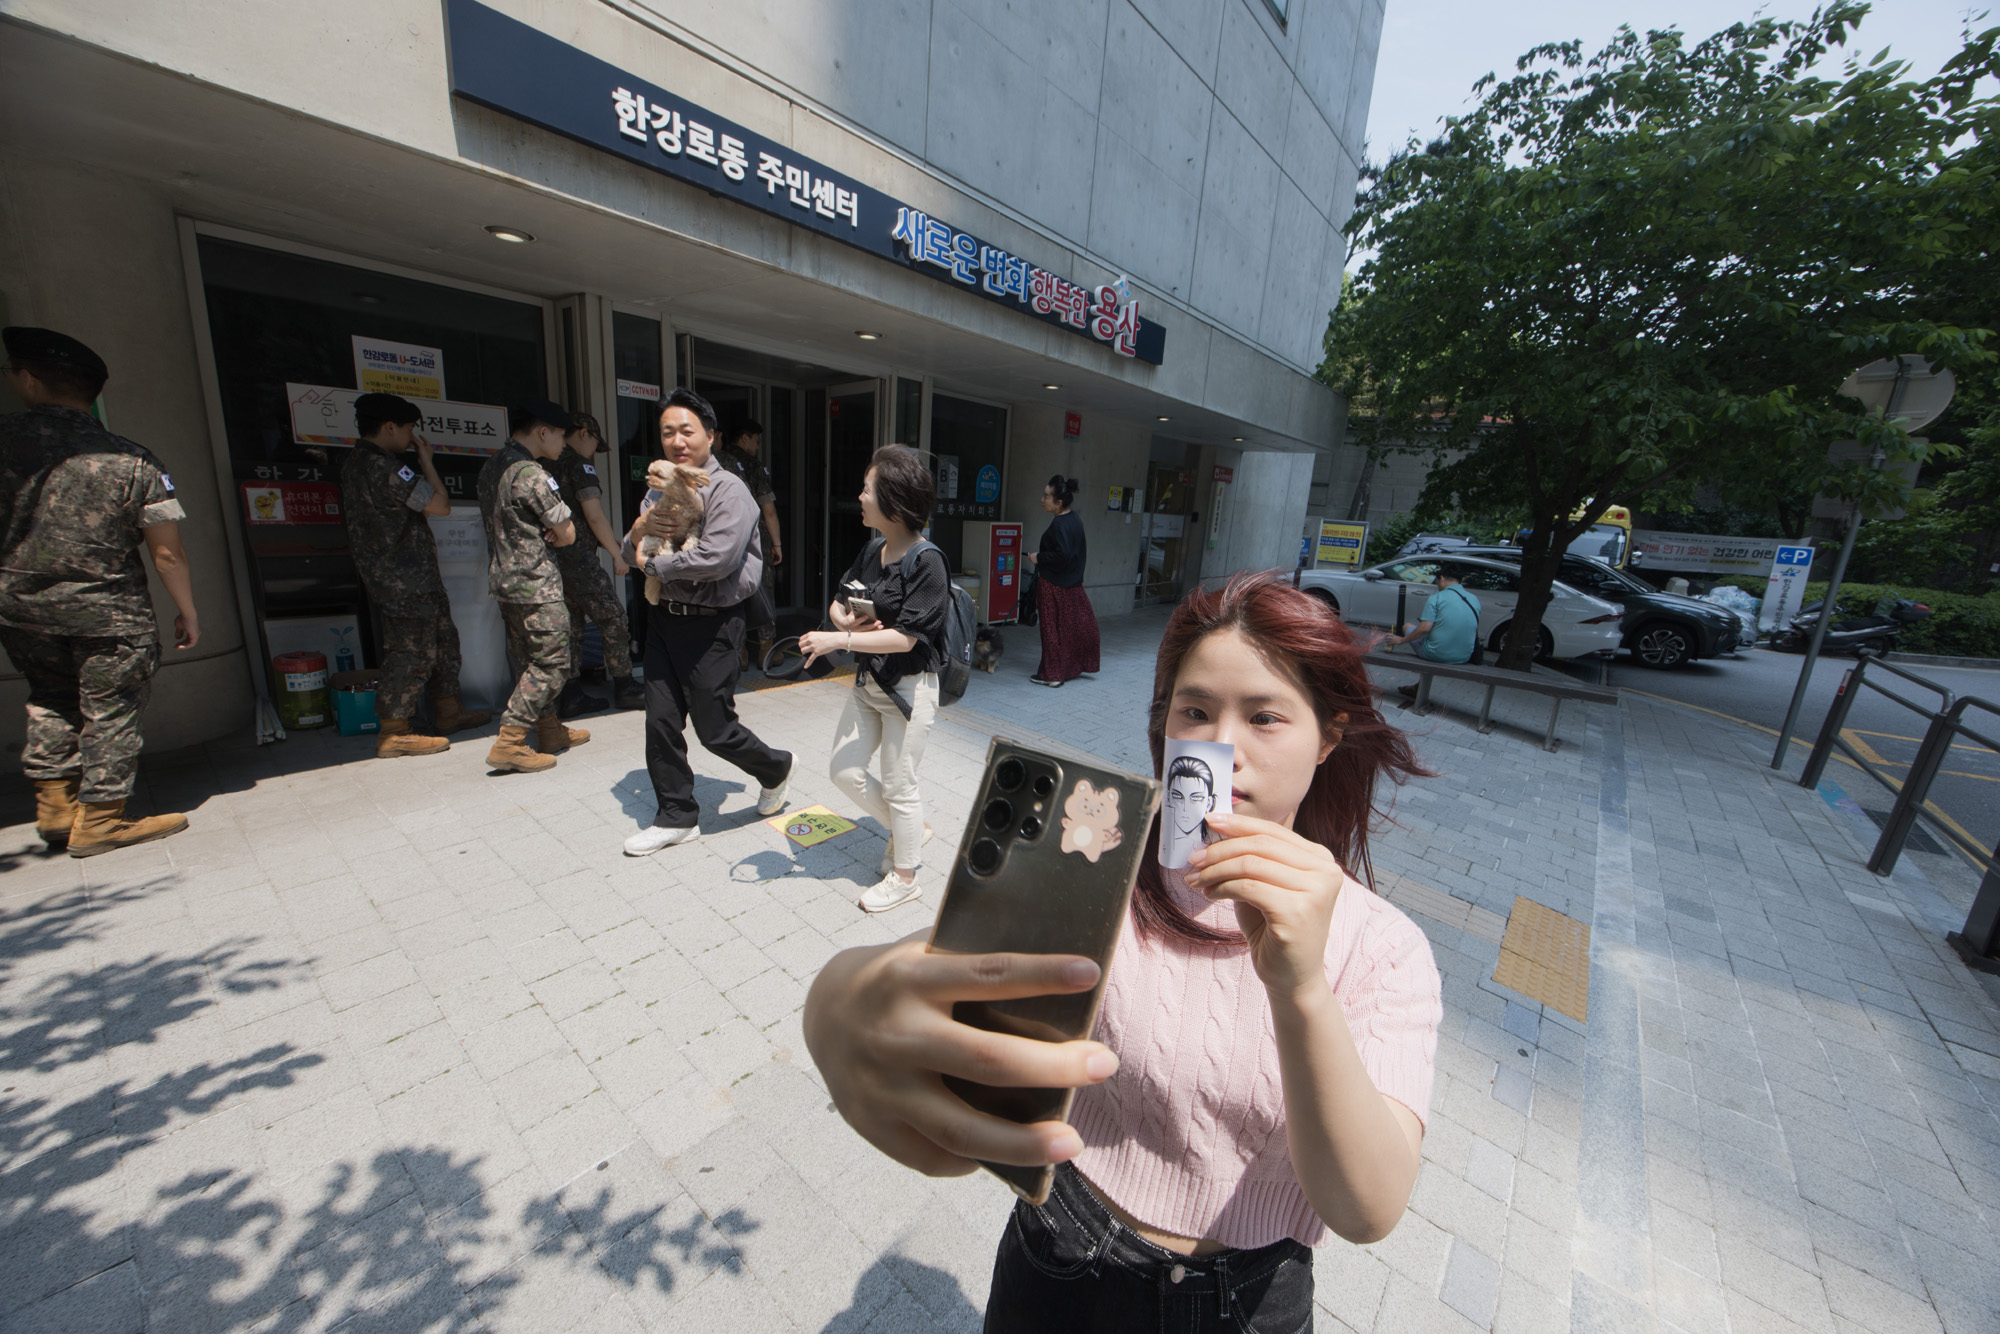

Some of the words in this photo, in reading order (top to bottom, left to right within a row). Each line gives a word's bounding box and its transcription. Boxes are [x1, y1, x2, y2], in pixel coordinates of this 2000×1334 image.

[611, 86, 749, 181] 한강로동
[756, 151, 858, 228] 주민센터
[892, 206, 980, 285] 새로운
[980, 245, 1031, 303] 변화
[1030, 267, 1090, 329] 행복한
[1090, 284, 1141, 357] 용산
[362, 348, 399, 364] 한강로동
[1713, 546, 1750, 559] 건강한
[1792, 549, 1808, 564] P
